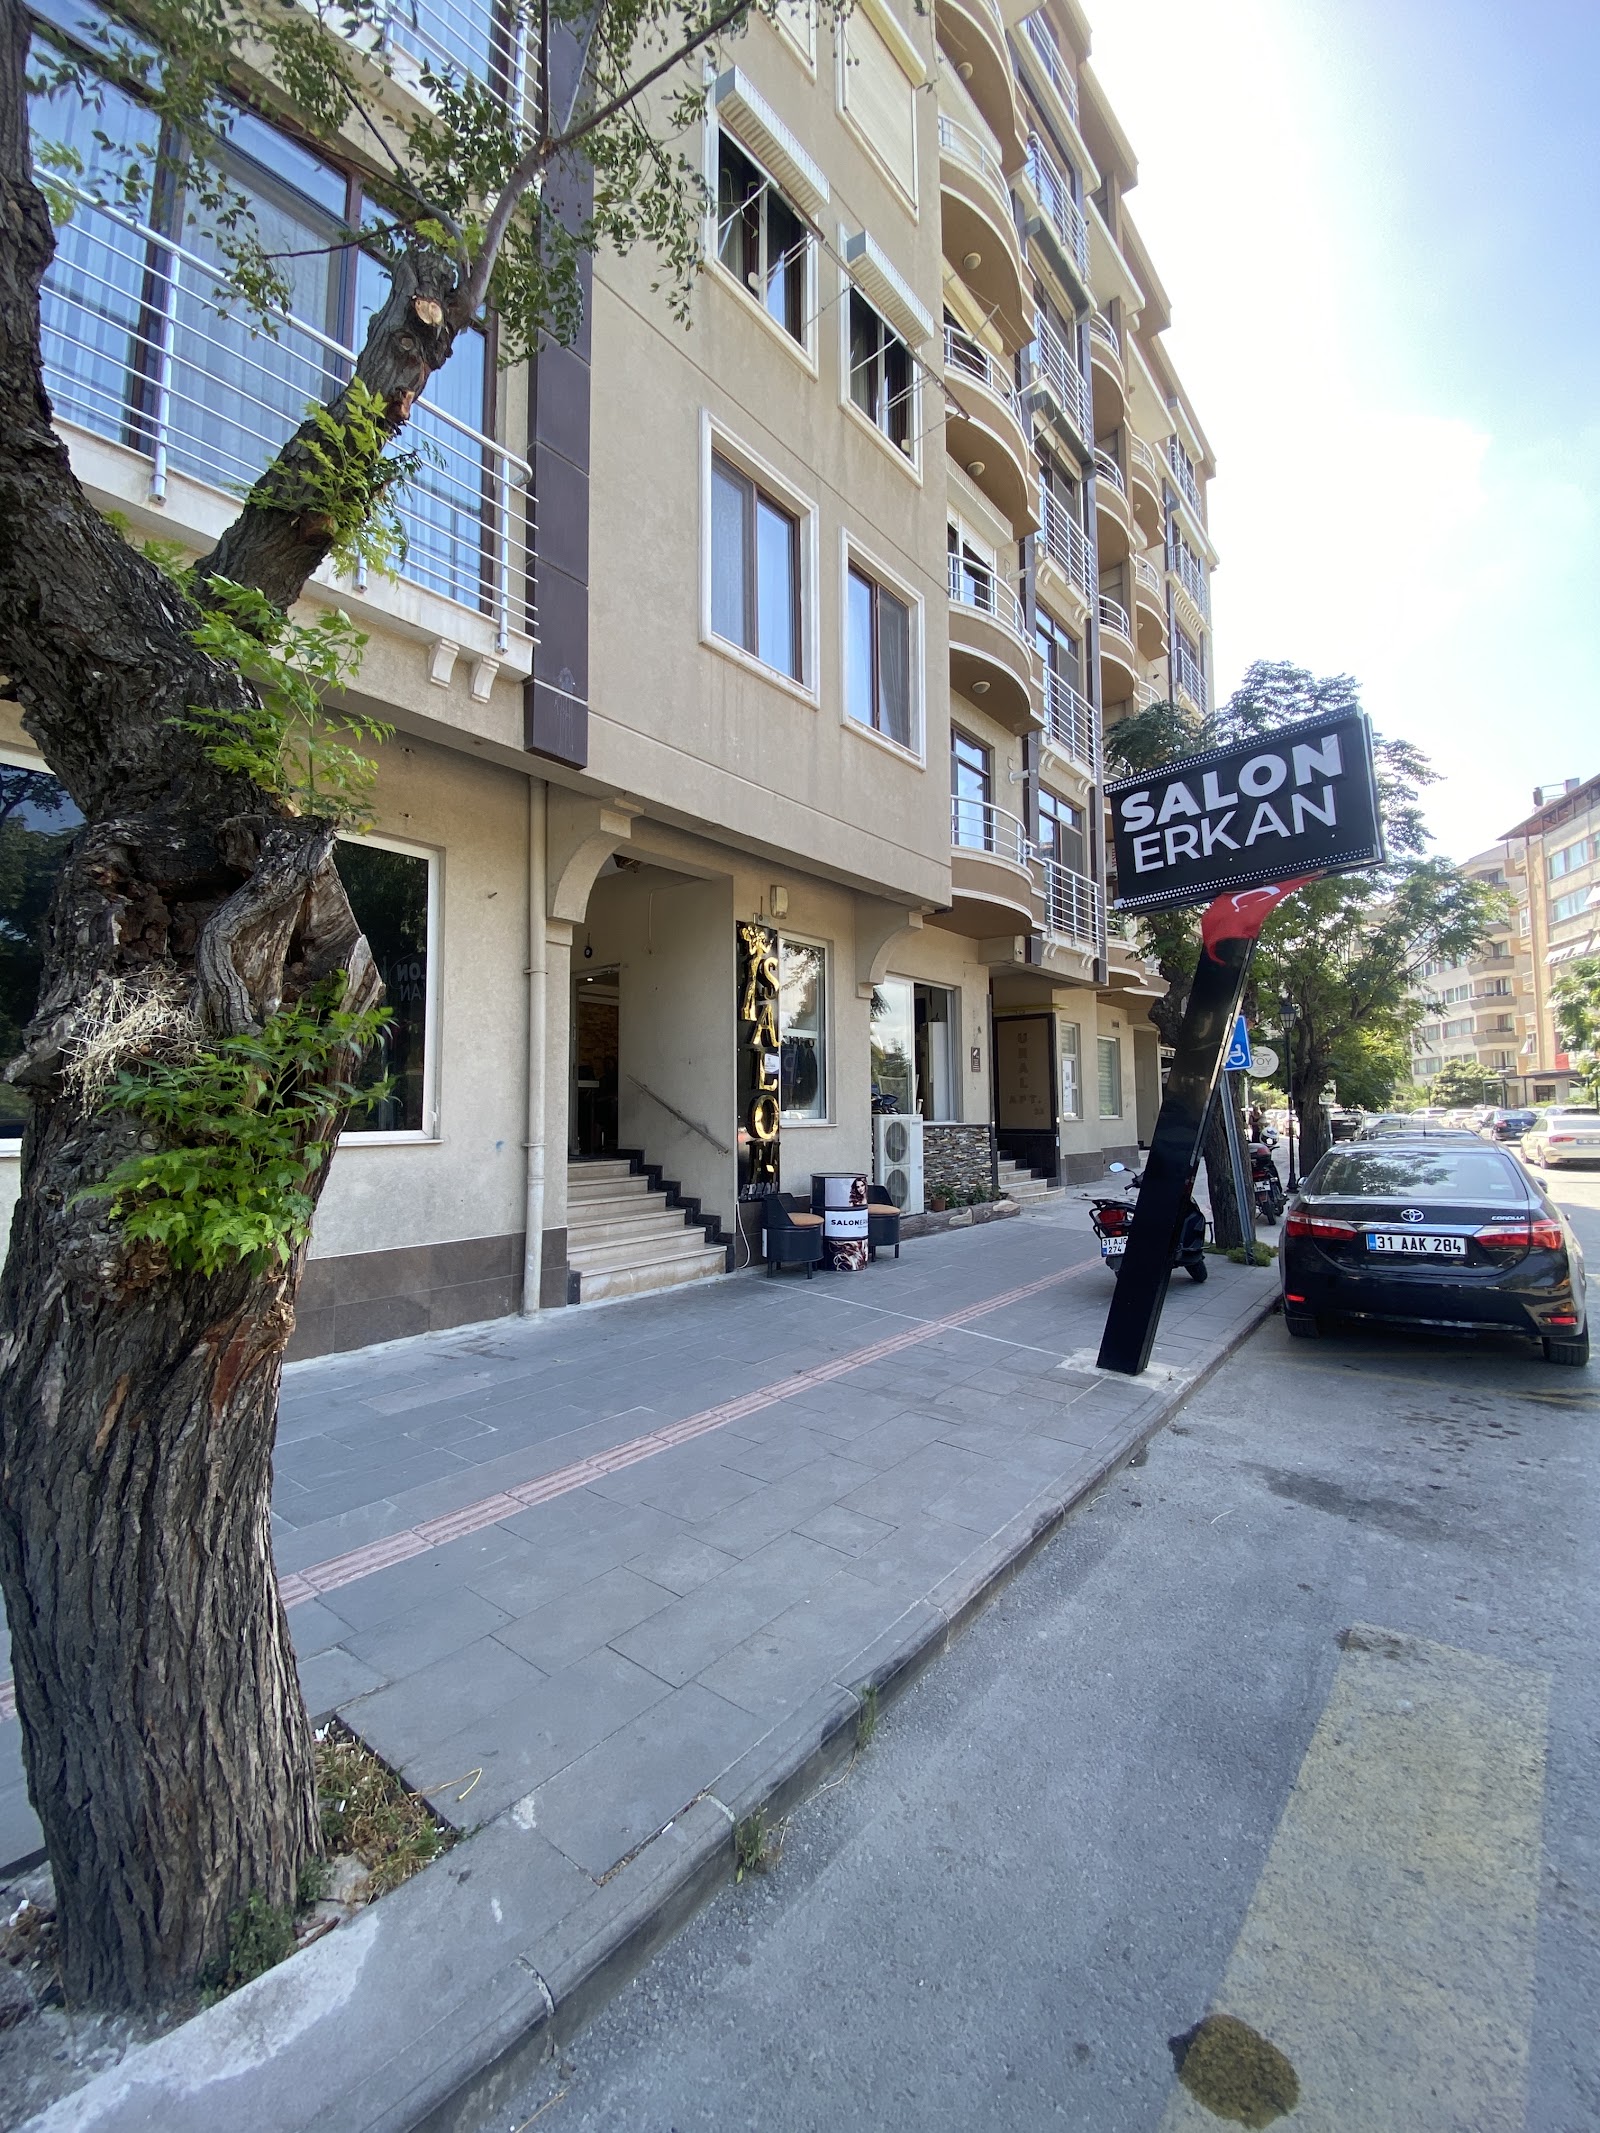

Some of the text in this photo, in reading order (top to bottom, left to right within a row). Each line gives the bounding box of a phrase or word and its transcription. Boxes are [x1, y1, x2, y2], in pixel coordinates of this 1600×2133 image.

[1119, 733, 1343, 833] SALON
[1132, 784, 1338, 874] ERKAN
[1377, 1236, 1461, 1253] 31 AAK 284
